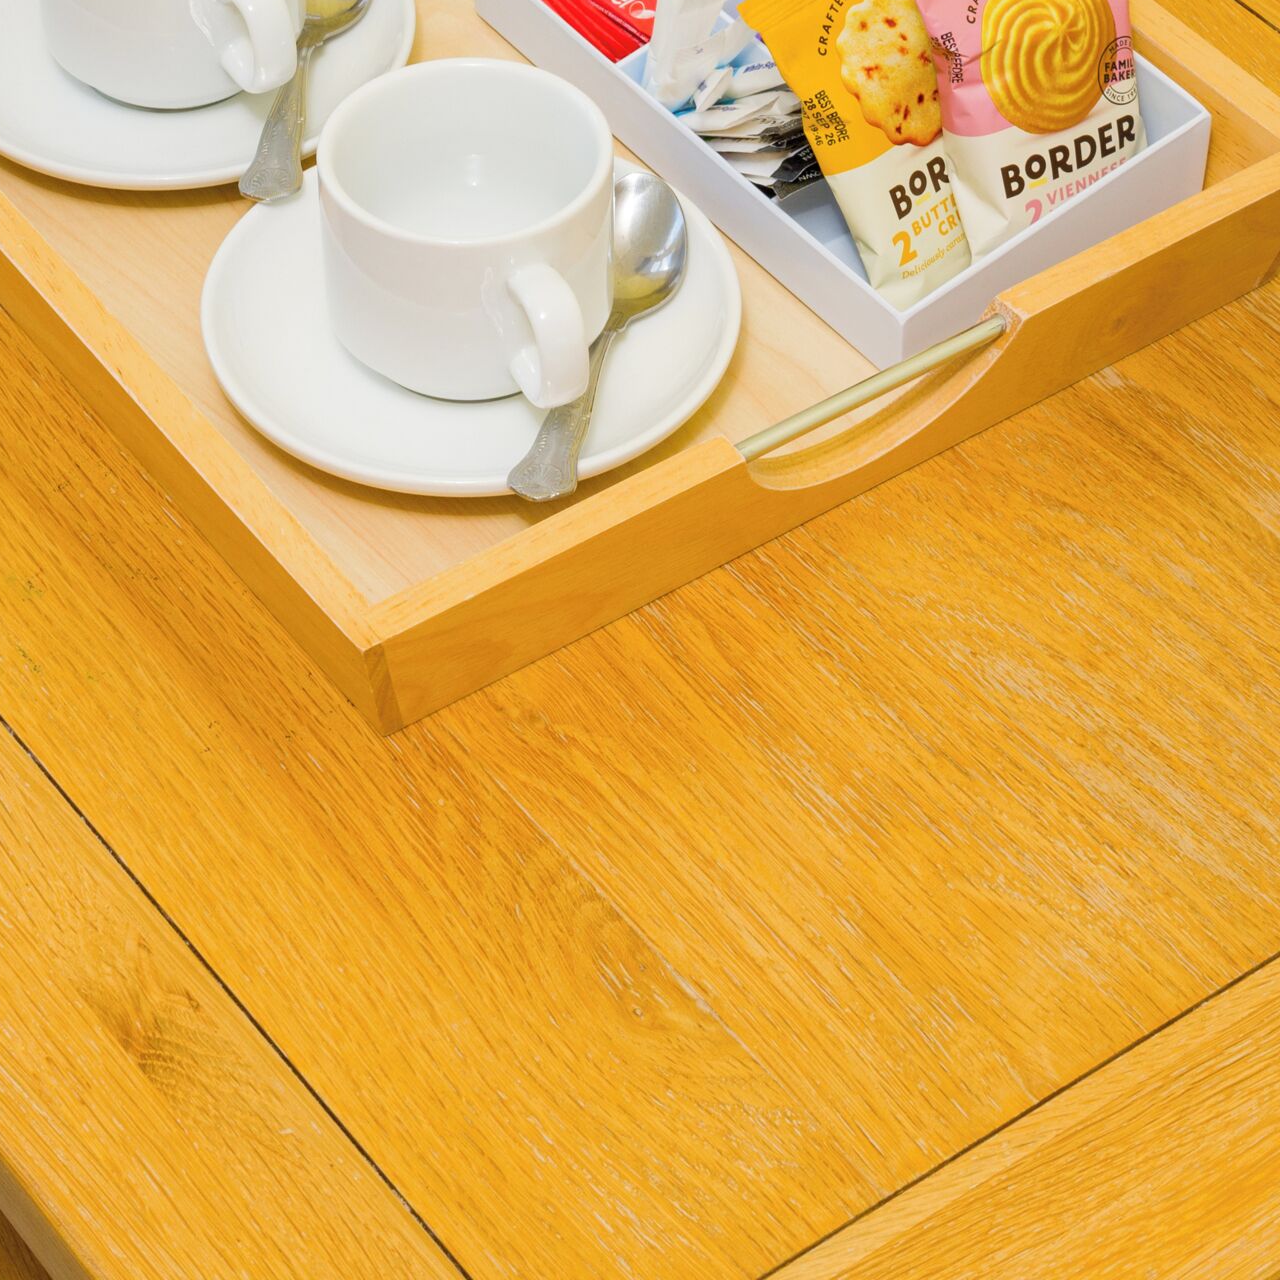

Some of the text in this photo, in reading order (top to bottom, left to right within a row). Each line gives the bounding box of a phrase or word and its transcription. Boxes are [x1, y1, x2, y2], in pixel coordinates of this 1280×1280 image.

[1109, 40, 1127, 54] MADE
[1106, 88, 1124, 101] SINCE
[804, 98, 816, 110] 28
[812, 112, 830, 129] SEP
[825, 133, 836, 146] 26
[815, 90, 850, 143] BEST BEFORE
[1001, 115, 1135, 199] BORDER
[889, 156, 950, 221] BOR
[1025, 199, 1043, 225] 2
[892, 230, 918, 267] 2
